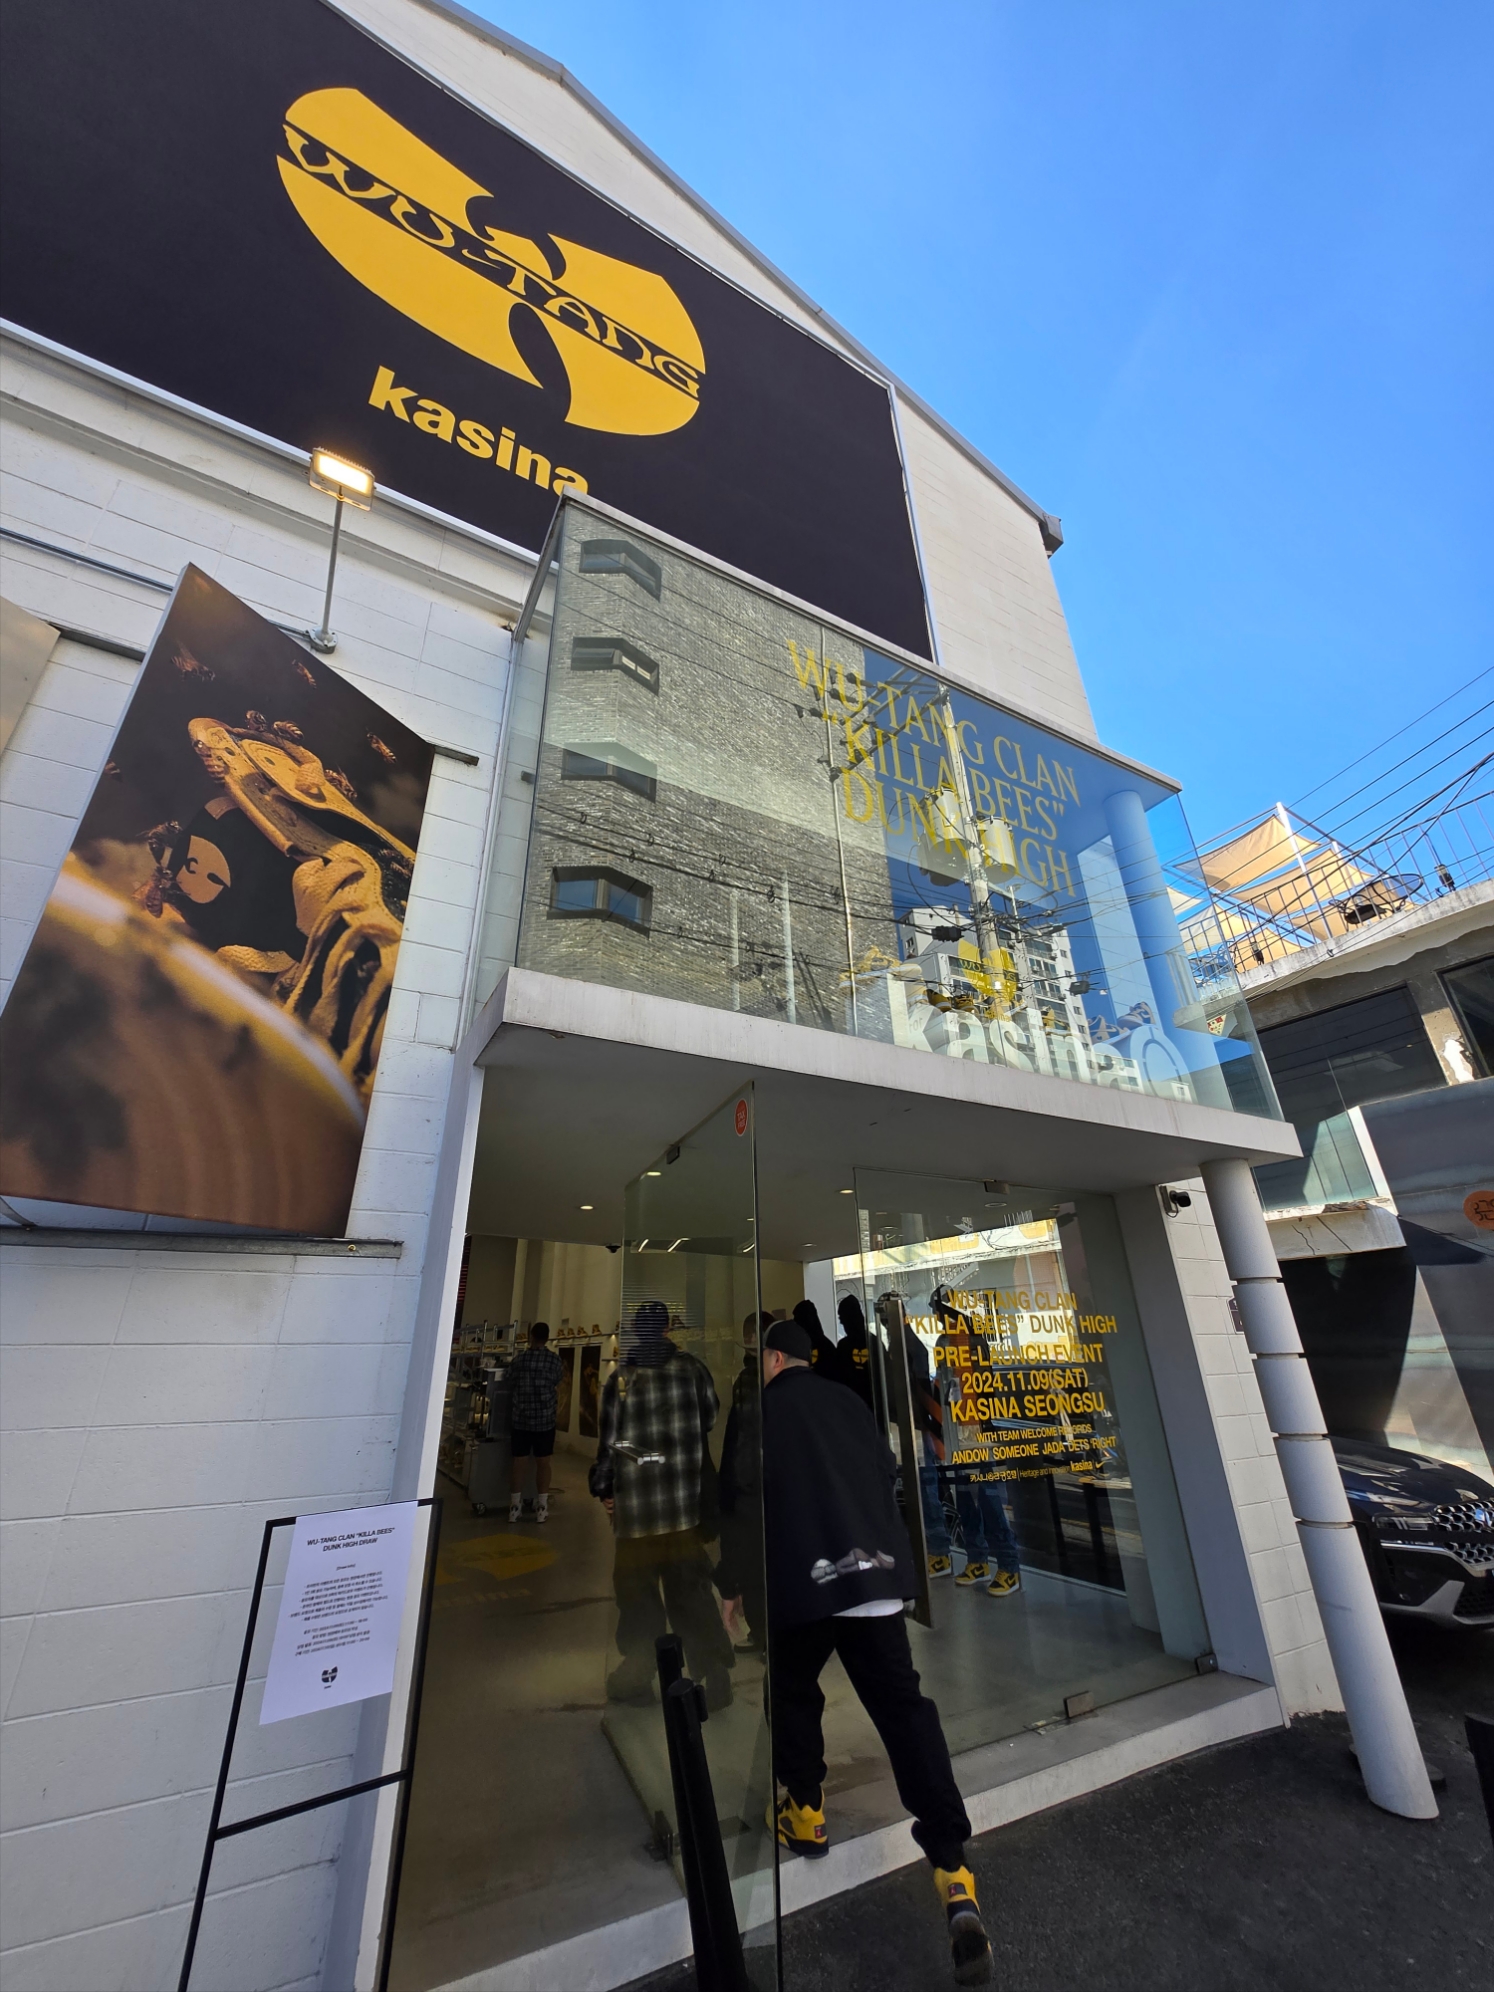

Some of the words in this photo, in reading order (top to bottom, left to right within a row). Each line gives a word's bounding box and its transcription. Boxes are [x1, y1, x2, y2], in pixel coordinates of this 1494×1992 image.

[368, 365, 589, 497] kasina
[786, 638, 985, 765] WU-TANG
[992, 735, 1082, 807] CLAN
[839, 765, 970, 860] DUNK
[975, 819, 1077, 898] HIGH
[946, 1289, 1031, 1310] WU-TANG
[1034, 1291, 1078, 1311] CLAN
[1028, 1314, 1078, 1334] DUNK
[1078, 1315, 1118, 1334] HIGH
[933, 1344, 1051, 1368] PRE-LAUNCH
[1052, 1343, 1104, 1364] EVENT
[961, 1367, 1089, 1394] 2024.11.09(SAT)
[950, 1396, 1022, 1423] KASINA
[1024, 1391, 1105, 1417] SEONGSU
[976, 1431, 998, 1443] WITH
[998, 1429, 1021, 1441] TEAM
[1020, 1426, 1058, 1440] WELCOME
[951, 1447, 990, 1464] ANDOW
[992, 1443, 1040, 1460] SOMEONE
[1041, 1440, 1066, 1456] JADA
[1070, 1459, 1094, 1473] kasina
[306, 1536, 338, 1546] WU-TANG
[337, 1533, 356, 1542] CLAN
[322, 1543, 342, 1552] DUNK
[342, 1540, 359, 1549] HIGH
